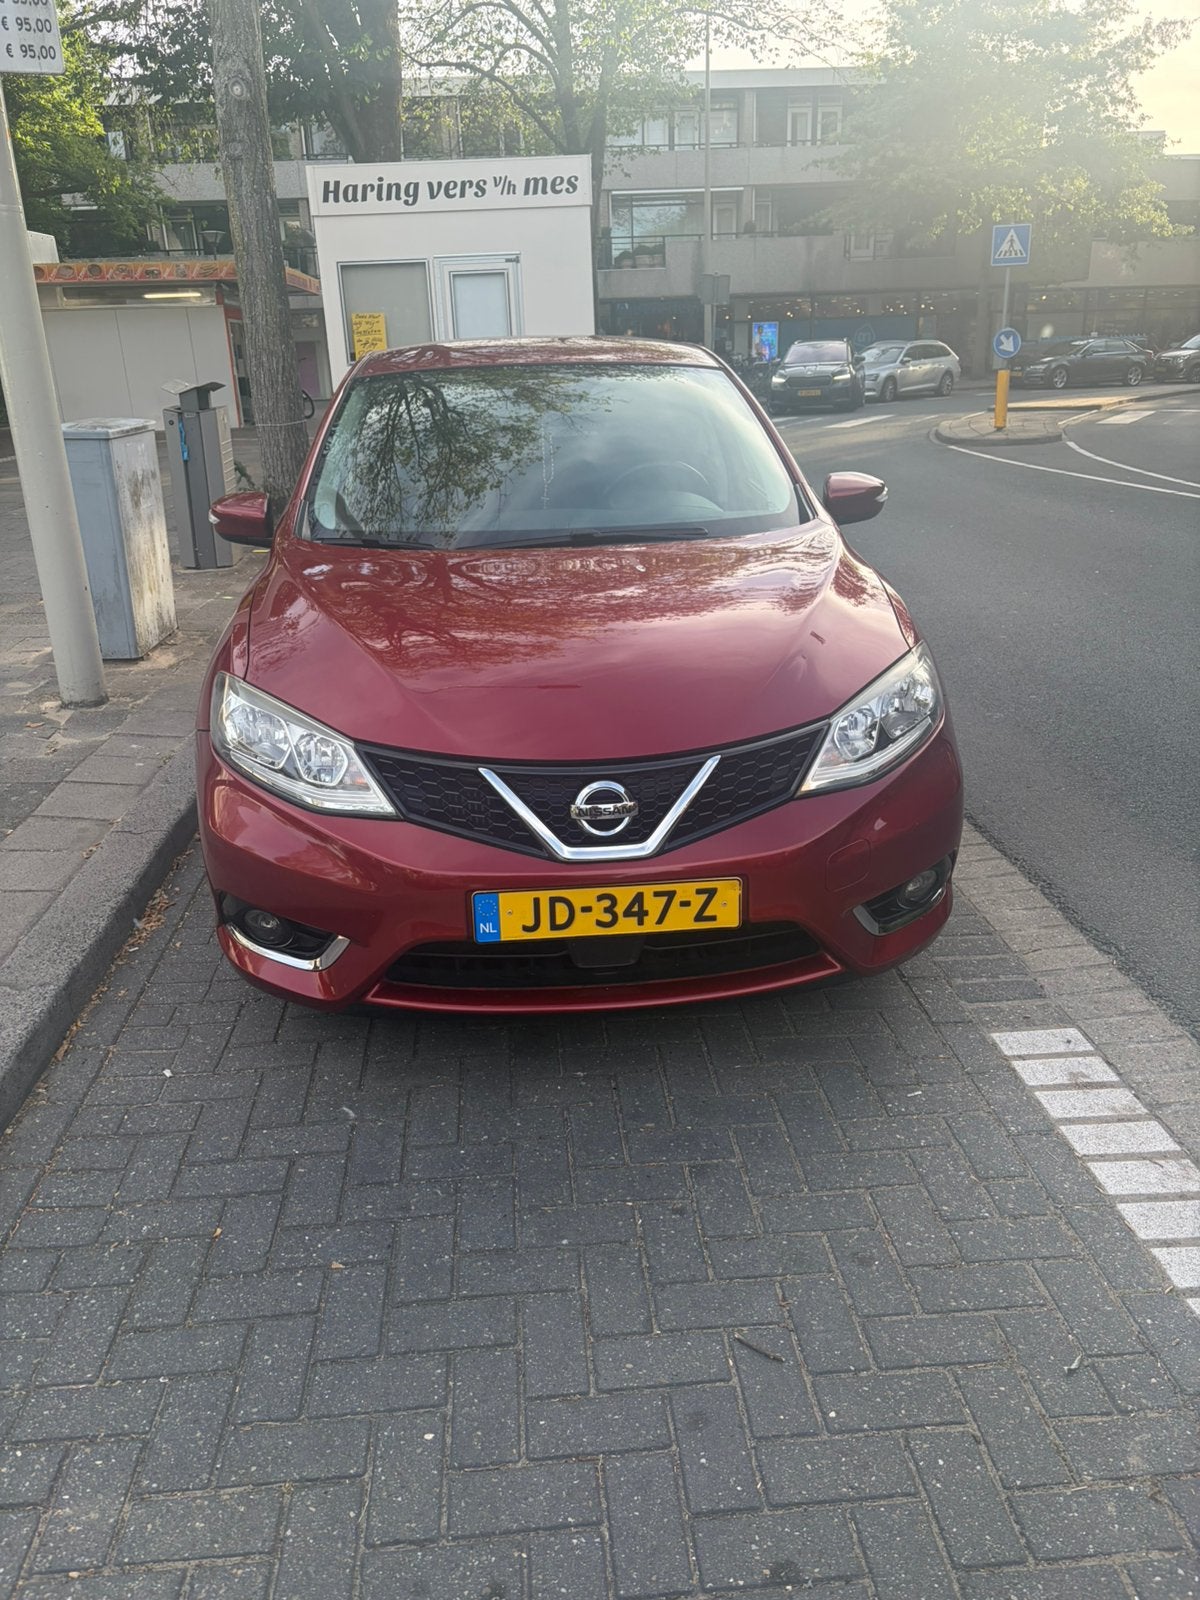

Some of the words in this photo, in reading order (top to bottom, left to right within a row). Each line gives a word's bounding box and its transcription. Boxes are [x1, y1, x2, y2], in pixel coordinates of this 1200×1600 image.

[1, 16, 10, 31] €
[15, 17, 52, 33] 95,00
[6, 43, 14, 58] €
[20, 44, 57, 60] 95,00
[322, 176, 420, 207] Haring
[427, 178, 487, 200] vers
[523, 174, 579, 197] mes
[577, 803, 633, 818] NISSAN
[521, 887, 719, 933] JD-347-Z
[480, 923, 497, 934] NL
